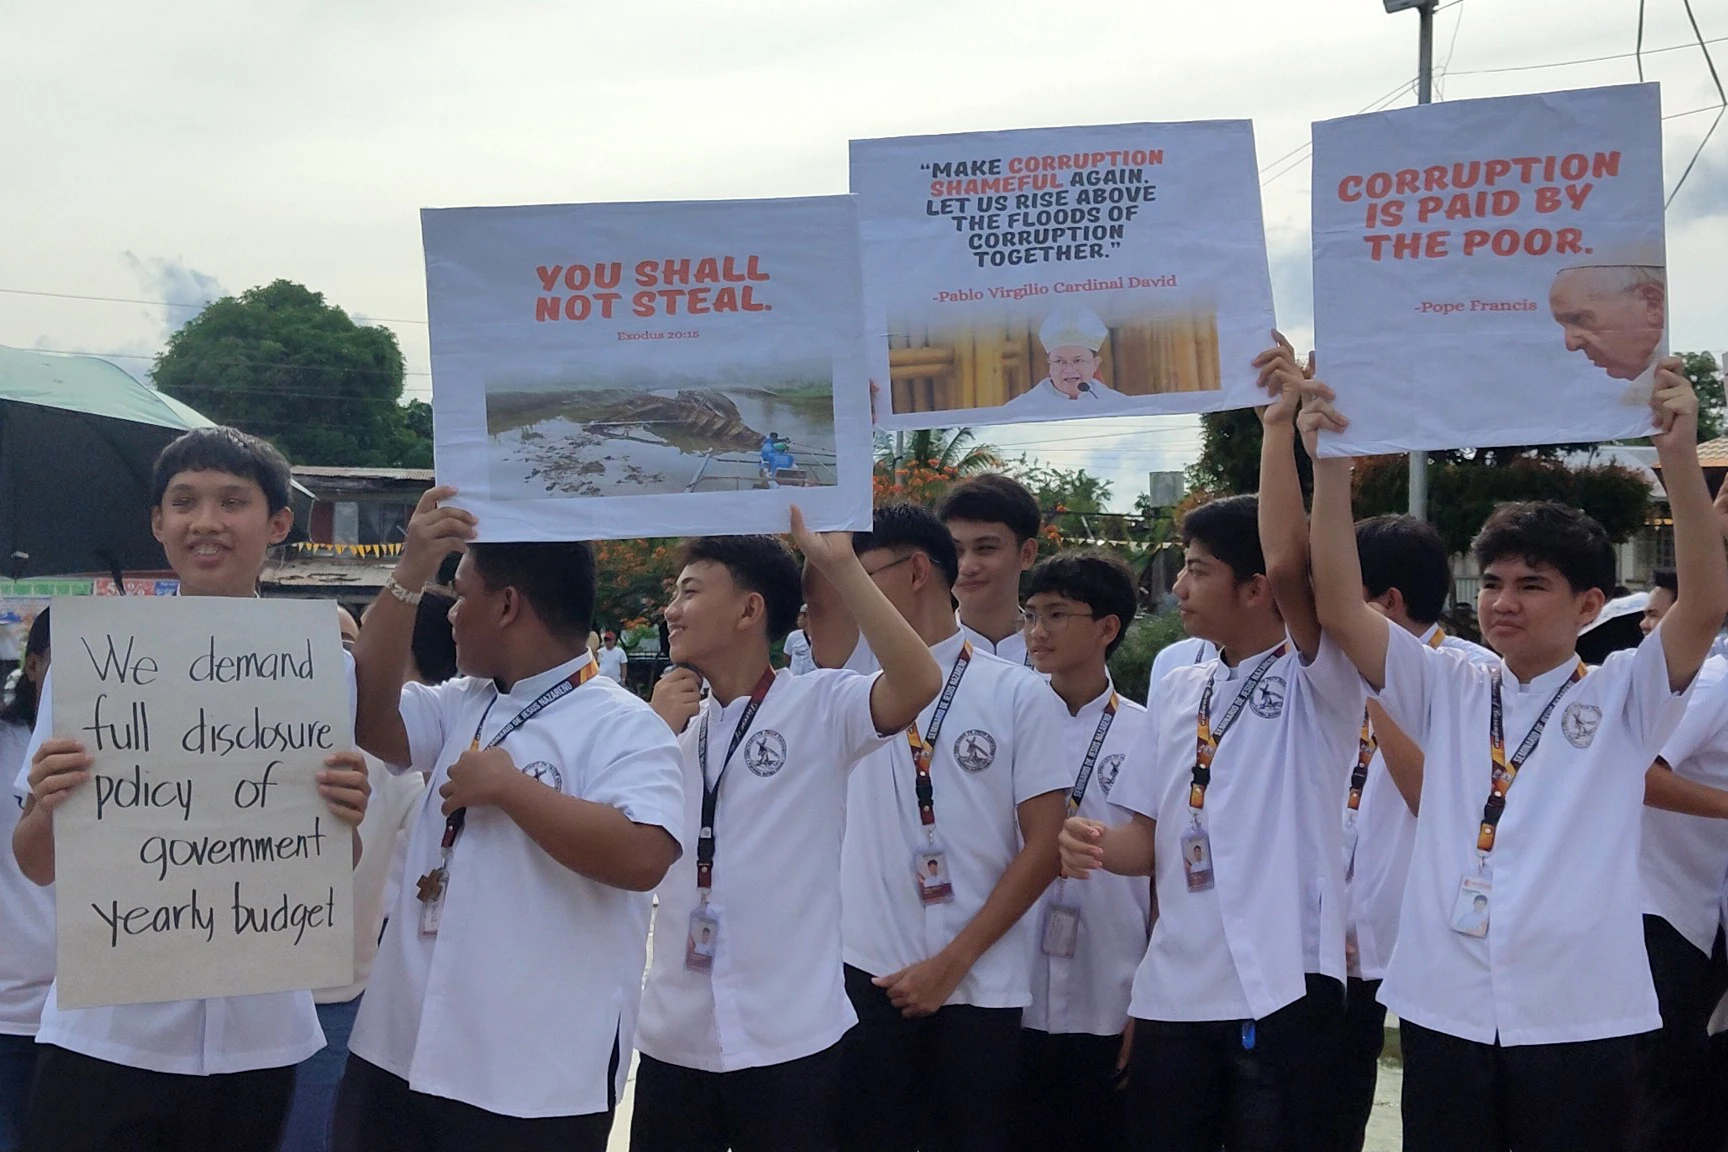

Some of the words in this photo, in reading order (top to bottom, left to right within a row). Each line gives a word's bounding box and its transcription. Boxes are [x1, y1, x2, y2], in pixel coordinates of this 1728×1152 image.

[1008, 149, 1164, 174] CORRUPTION
[1337, 150, 1621, 203] CORRUPTION
[926, 198, 971, 216] LET
[977, 195, 1007, 213] US
[1016, 191, 1069, 209] RISE
[1076, 186, 1156, 205] ABOVE
[930, 173, 1064, 198] SHAMEFUL
[1070, 169, 1149, 187] AGAIN.
[951, 215, 999, 232] THE
[1008, 207, 1101, 229] FLOODS
[1108, 205, 1139, 223] OF
[1365, 202, 1404, 229] IS
[1418, 191, 1520, 223] PAID
[1534, 183, 1594, 213] BY
[968, 224, 1124, 250] CORRUPTION
[1363, 231, 1449, 261] THE
[1462, 228, 1594, 257] POOR.
[535, 262, 622, 292] YOU
[634, 255, 770, 286] SHALL
[932, 289, 983, 303] -Pablo
[987, 282, 1049, 300] Virgilio
[1054, 277, 1123, 294] Cardinal
[1128, 275, 1177, 289] David
[535, 293, 622, 322] NOT
[632, 285, 772, 318] STEAL.
[1414, 301, 1465, 315] -Pope
[1469, 299, 1537, 312] Francis
[617, 330, 664, 342] Exodus
[667, 330, 700, 340] 20:15
[81, 633, 158, 685] We
[189, 635, 313, 682] demand
[512, 716, 522, 726] DE
[521, 701, 541, 719] JESUS
[538, 682, 573, 707] NAZARENO
[927, 708, 946, 740] SEMINARIO
[943, 685, 956, 702] JESUS
[1214, 704, 1240, 736] SEMINARIO
[1234, 696, 1246, 706] DE
[1241, 679, 1257, 699] JESUS
[1251, 654, 1279, 681] NAZARENO
[82, 695, 149, 752] full
[181, 706, 333, 756] disclosure
[1513, 731, 1539, 764] SEMINARIO
[94, 765, 192, 822] policy
[234, 760, 285, 808] of
[140, 816, 326, 882] government
[232, 881, 334, 945] budget
